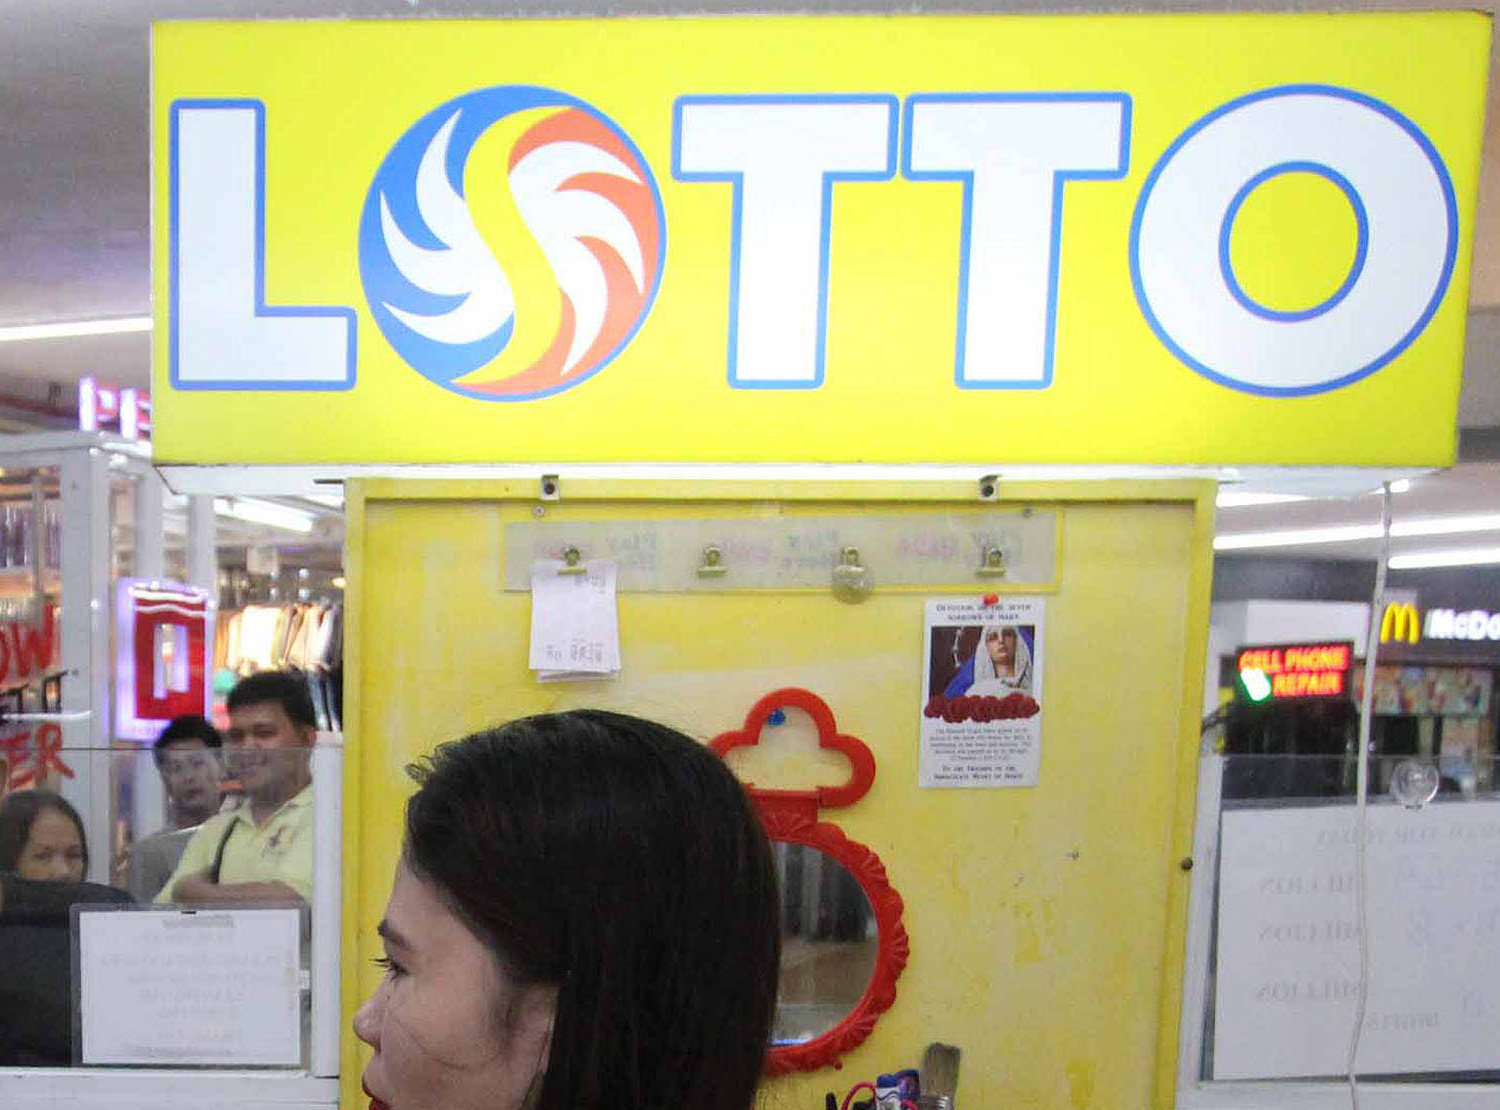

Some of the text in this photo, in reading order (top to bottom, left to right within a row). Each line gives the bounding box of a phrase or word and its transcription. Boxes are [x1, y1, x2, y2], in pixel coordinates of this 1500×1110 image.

[169, 84, 1458, 402] LOTTO
[1284, 646, 1350, 672] PHONE
[1273, 671, 1343, 698] REPAIR
